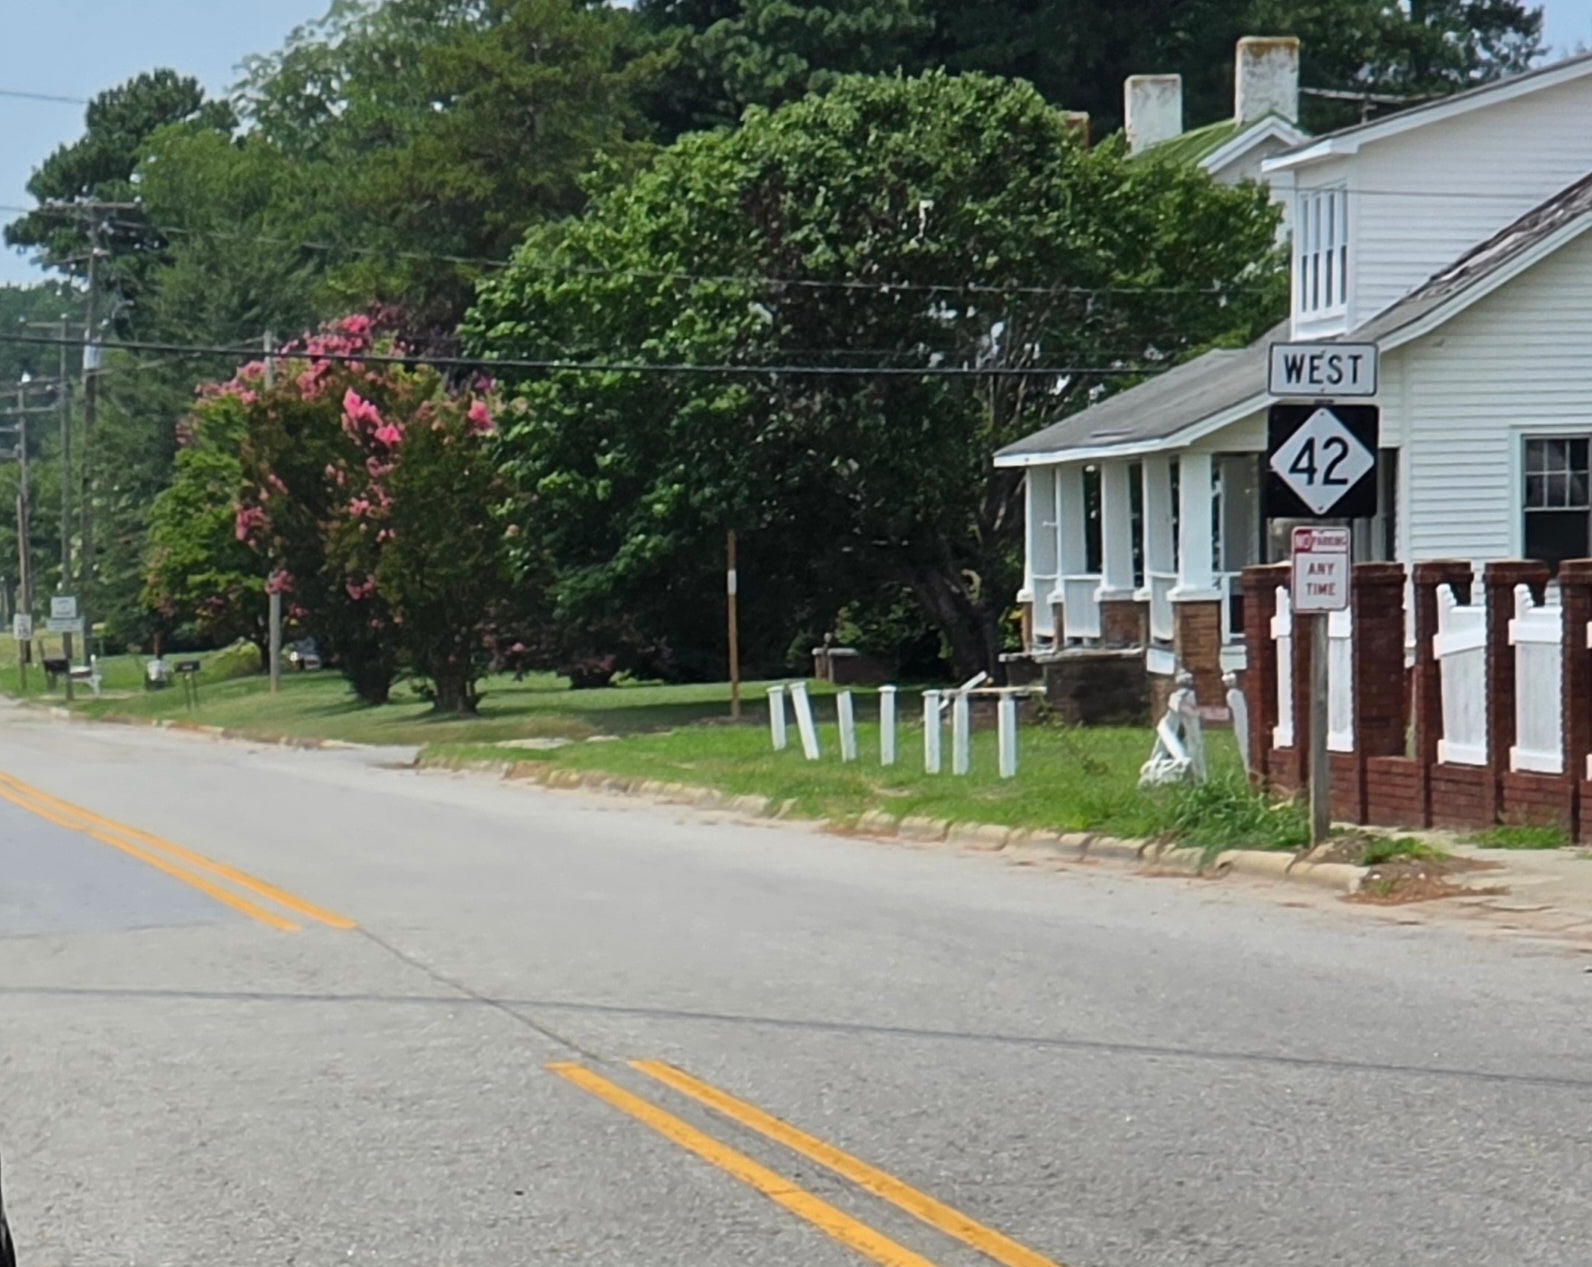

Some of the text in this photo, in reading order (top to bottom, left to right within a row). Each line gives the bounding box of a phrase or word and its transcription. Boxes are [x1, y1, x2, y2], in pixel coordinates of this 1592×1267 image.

[1284, 354, 1363, 385] WEST
[1288, 436, 1349, 486] 42
[1308, 562, 1335, 576] ANY
[1306, 583, 1336, 597] TIME
